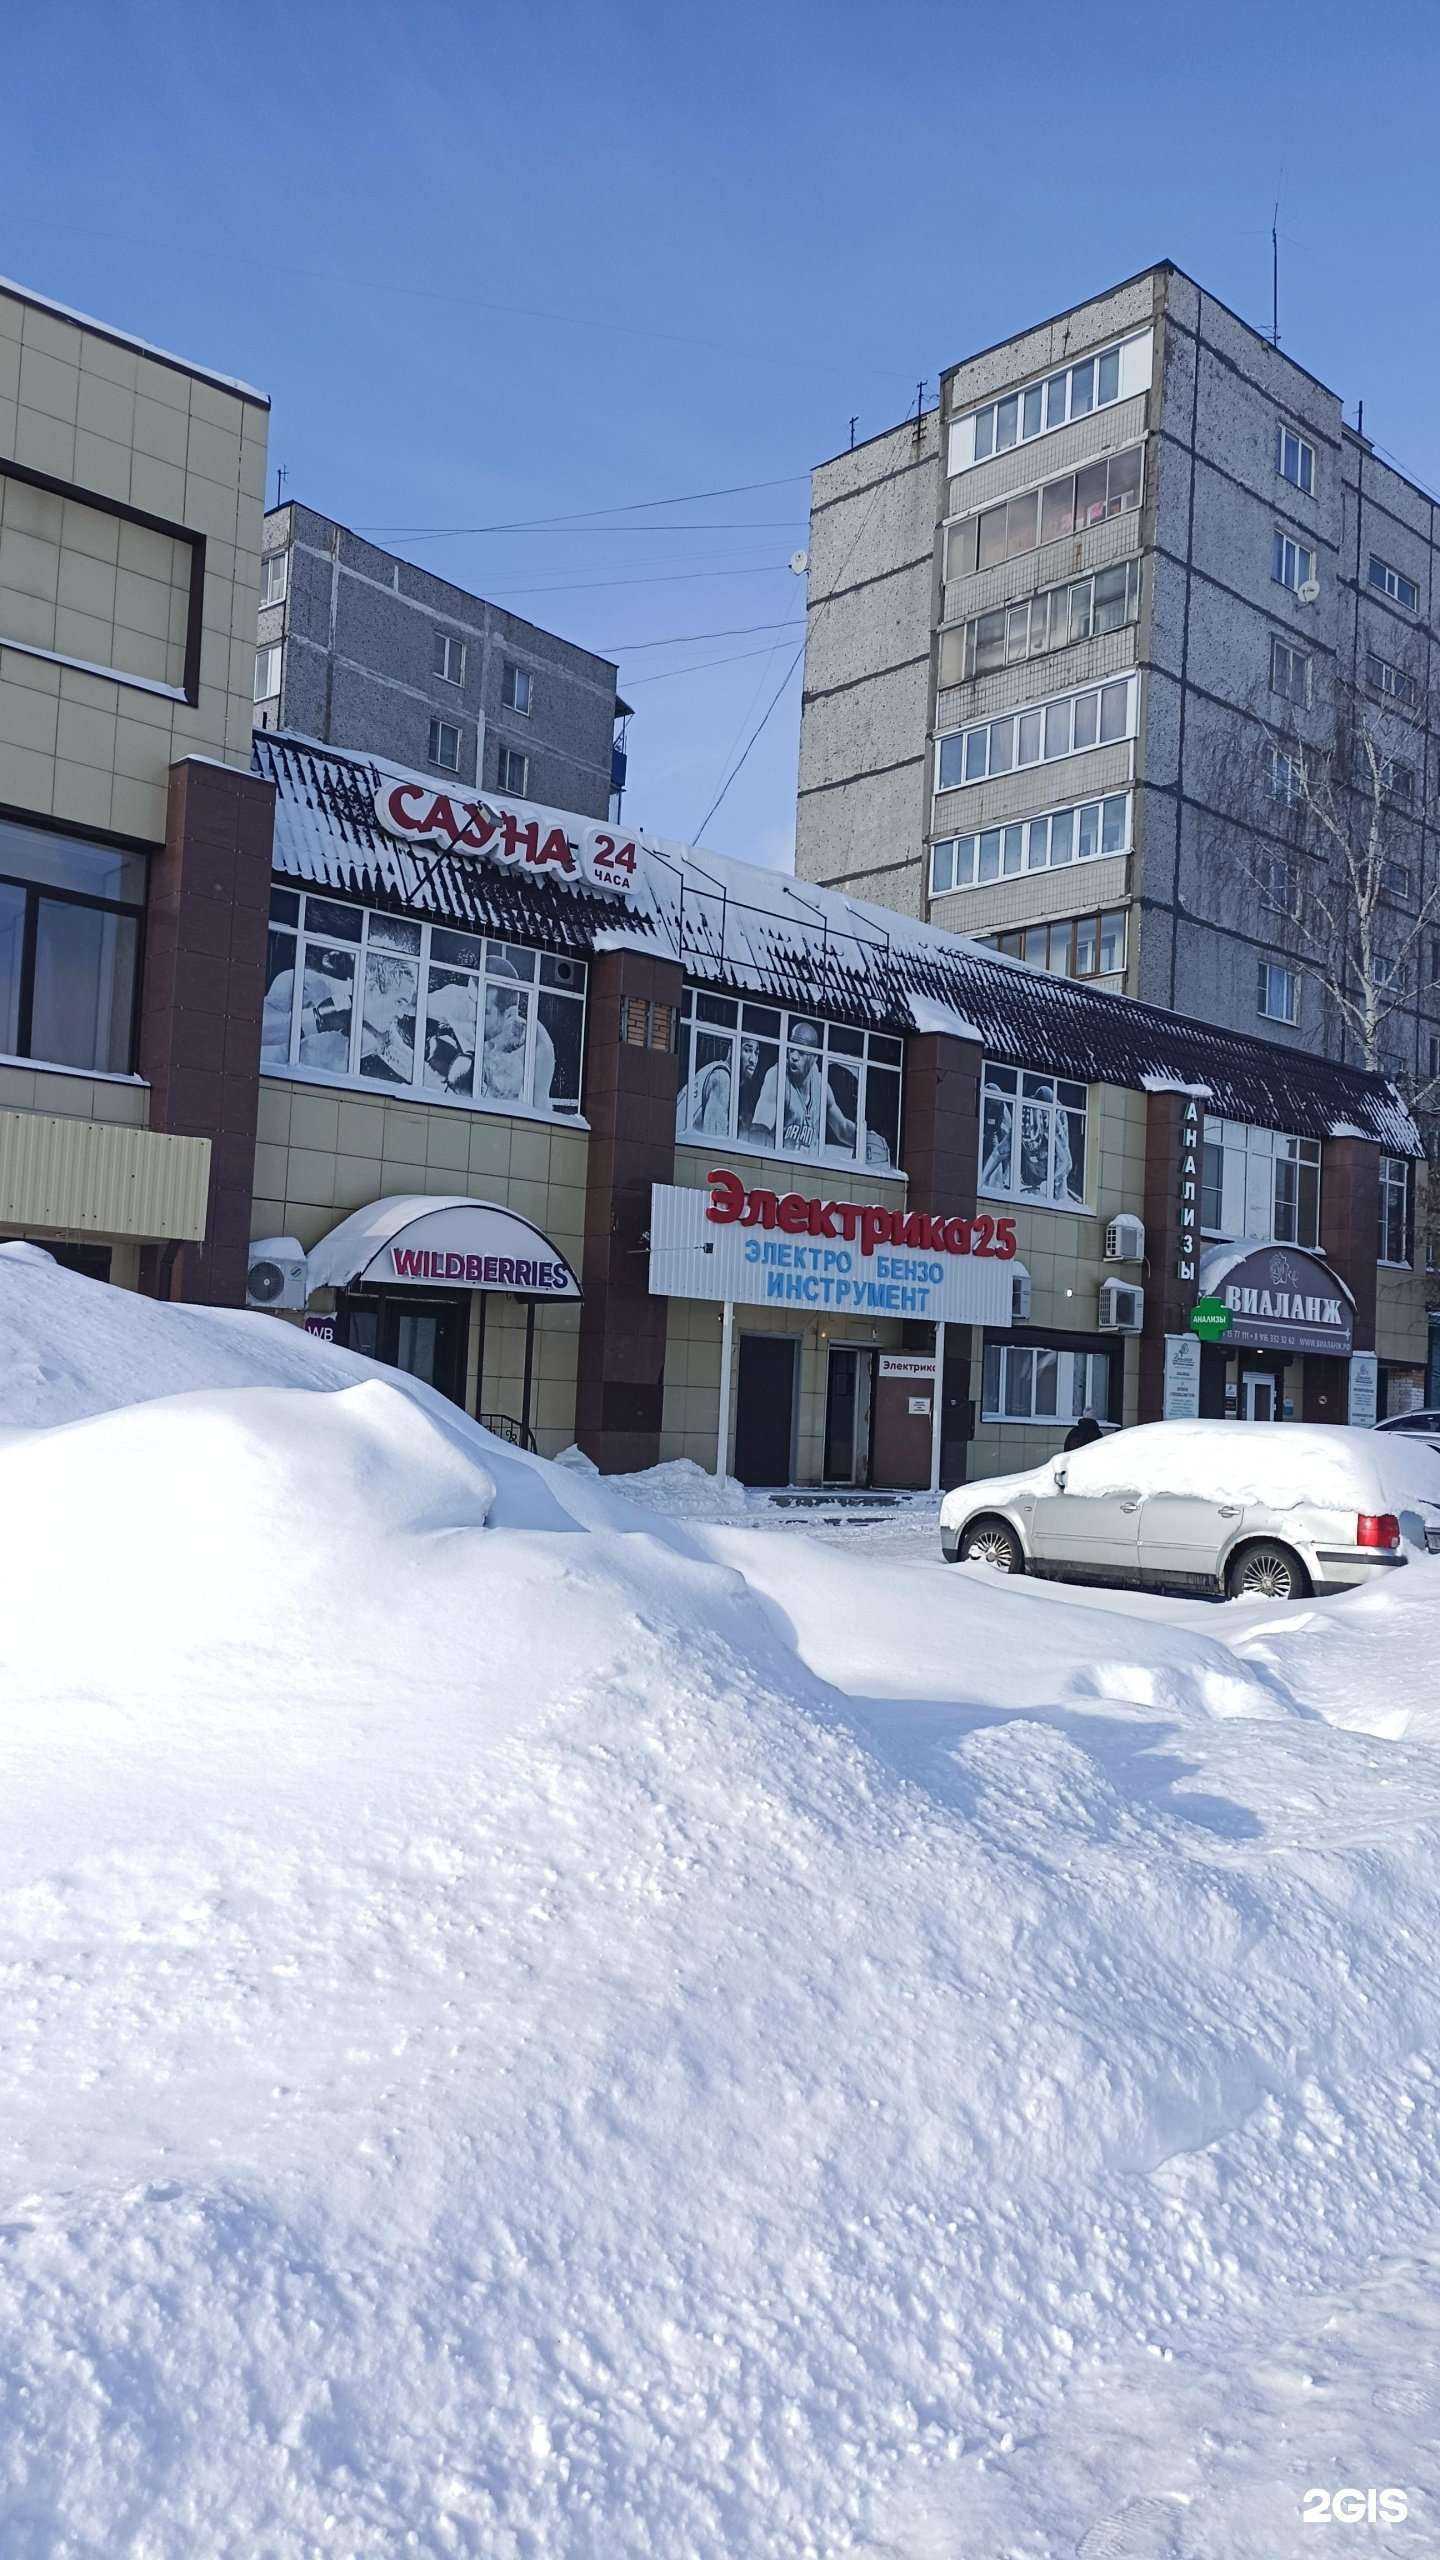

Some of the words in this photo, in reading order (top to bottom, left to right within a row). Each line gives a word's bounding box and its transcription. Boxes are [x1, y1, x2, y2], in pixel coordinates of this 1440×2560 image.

[388, 784, 576, 873] САУНА
[593, 834, 637, 873] 24
[594, 869, 631, 889] ЧАСА
[1178, 1102, 1198, 1281] АНАЛИЗЫ
[705, 1169, 1017, 1260] Электрика25
[394, 1248, 570, 1290] WILDBERRIES
[745, 1240, 852, 1275] ЭЛЕКТРО
[876, 1256, 945, 1285] БЕНЗО
[767, 1272, 931, 1313] ИНСТРУМЕНТ
[1225, 1285, 1342, 1325] ВИАЛАНЖ
[308, 1326, 334, 1342] WB
[1193, 1314, 1226, 1324] АНАЛИЗЫ
